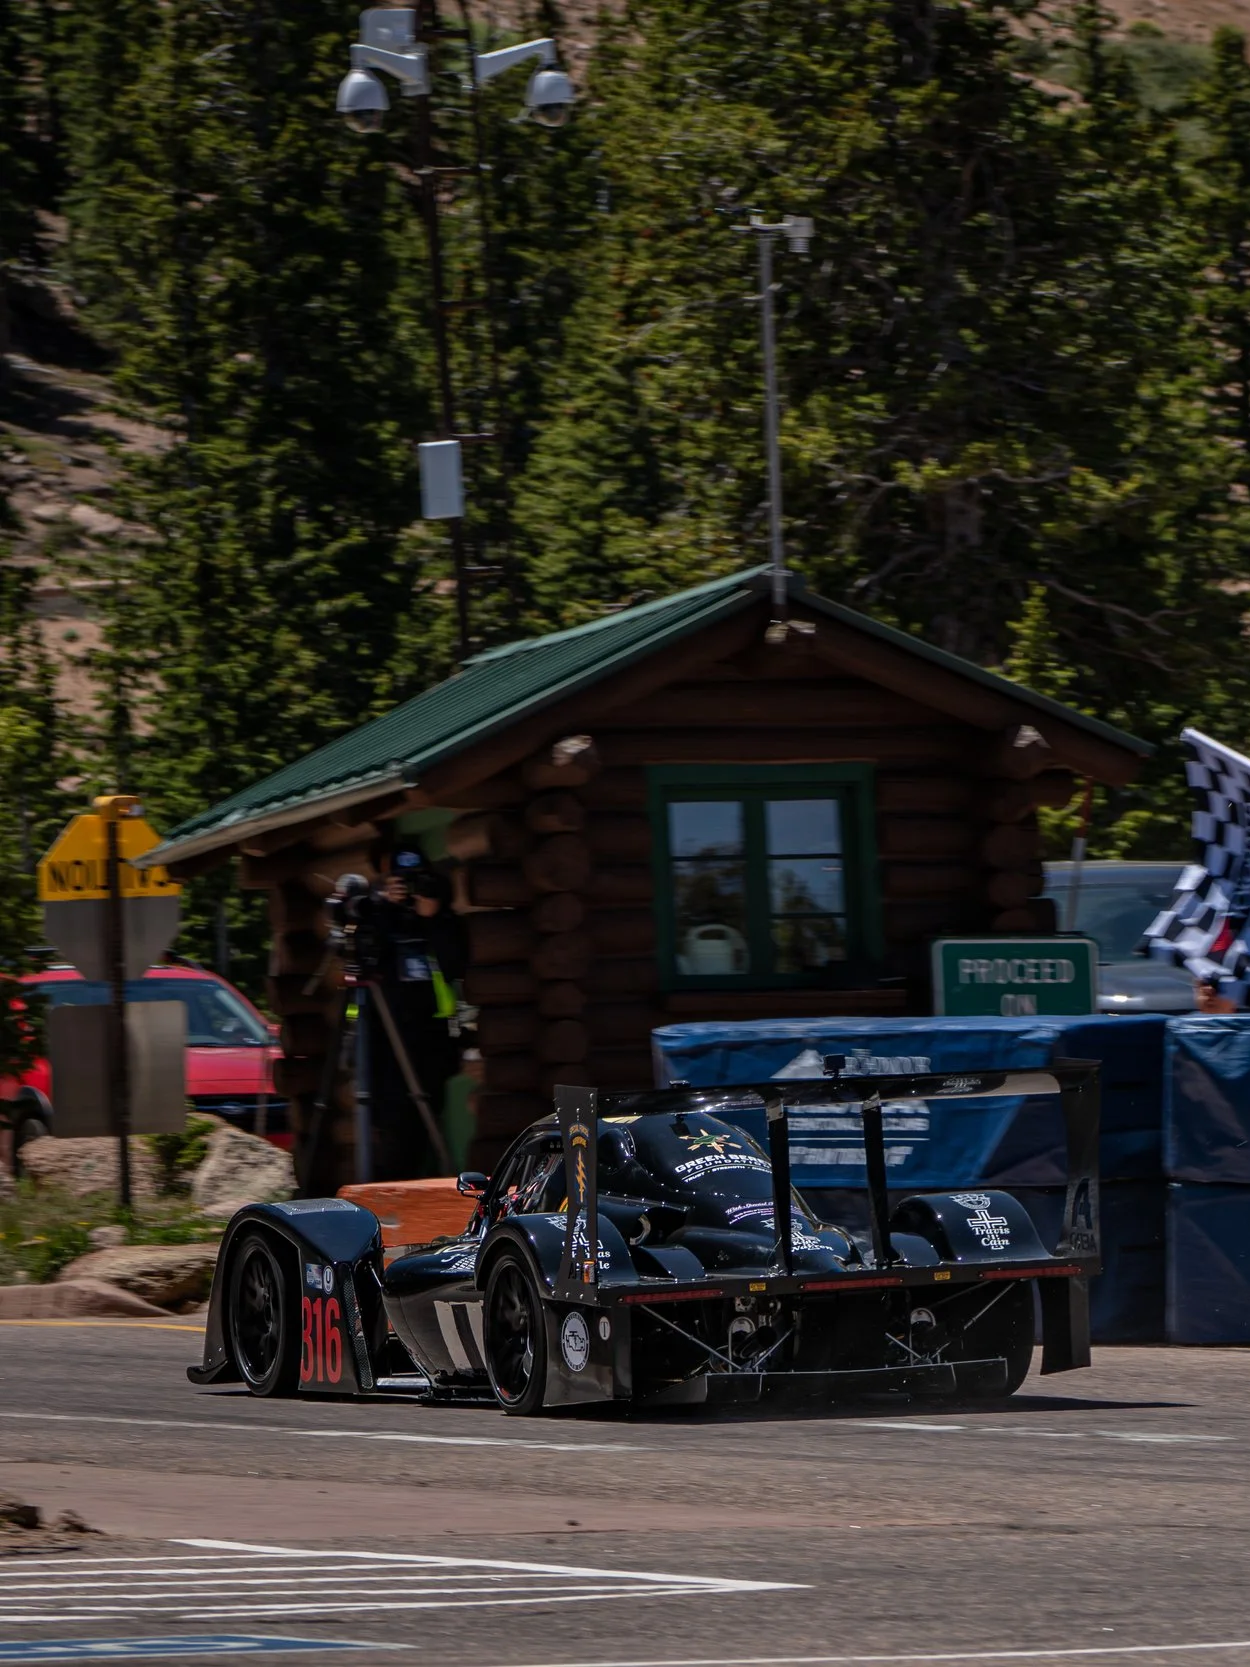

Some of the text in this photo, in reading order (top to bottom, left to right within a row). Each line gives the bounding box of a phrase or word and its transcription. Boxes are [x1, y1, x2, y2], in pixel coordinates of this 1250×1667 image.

[959, 958, 1075, 984] PROCEED
[1001, 993, 1038, 1016] ON
[674, 1154, 726, 1173] GREEN
[971, 1226, 1011, 1236] Travis
[981, 1237, 1011, 1247] Cain
